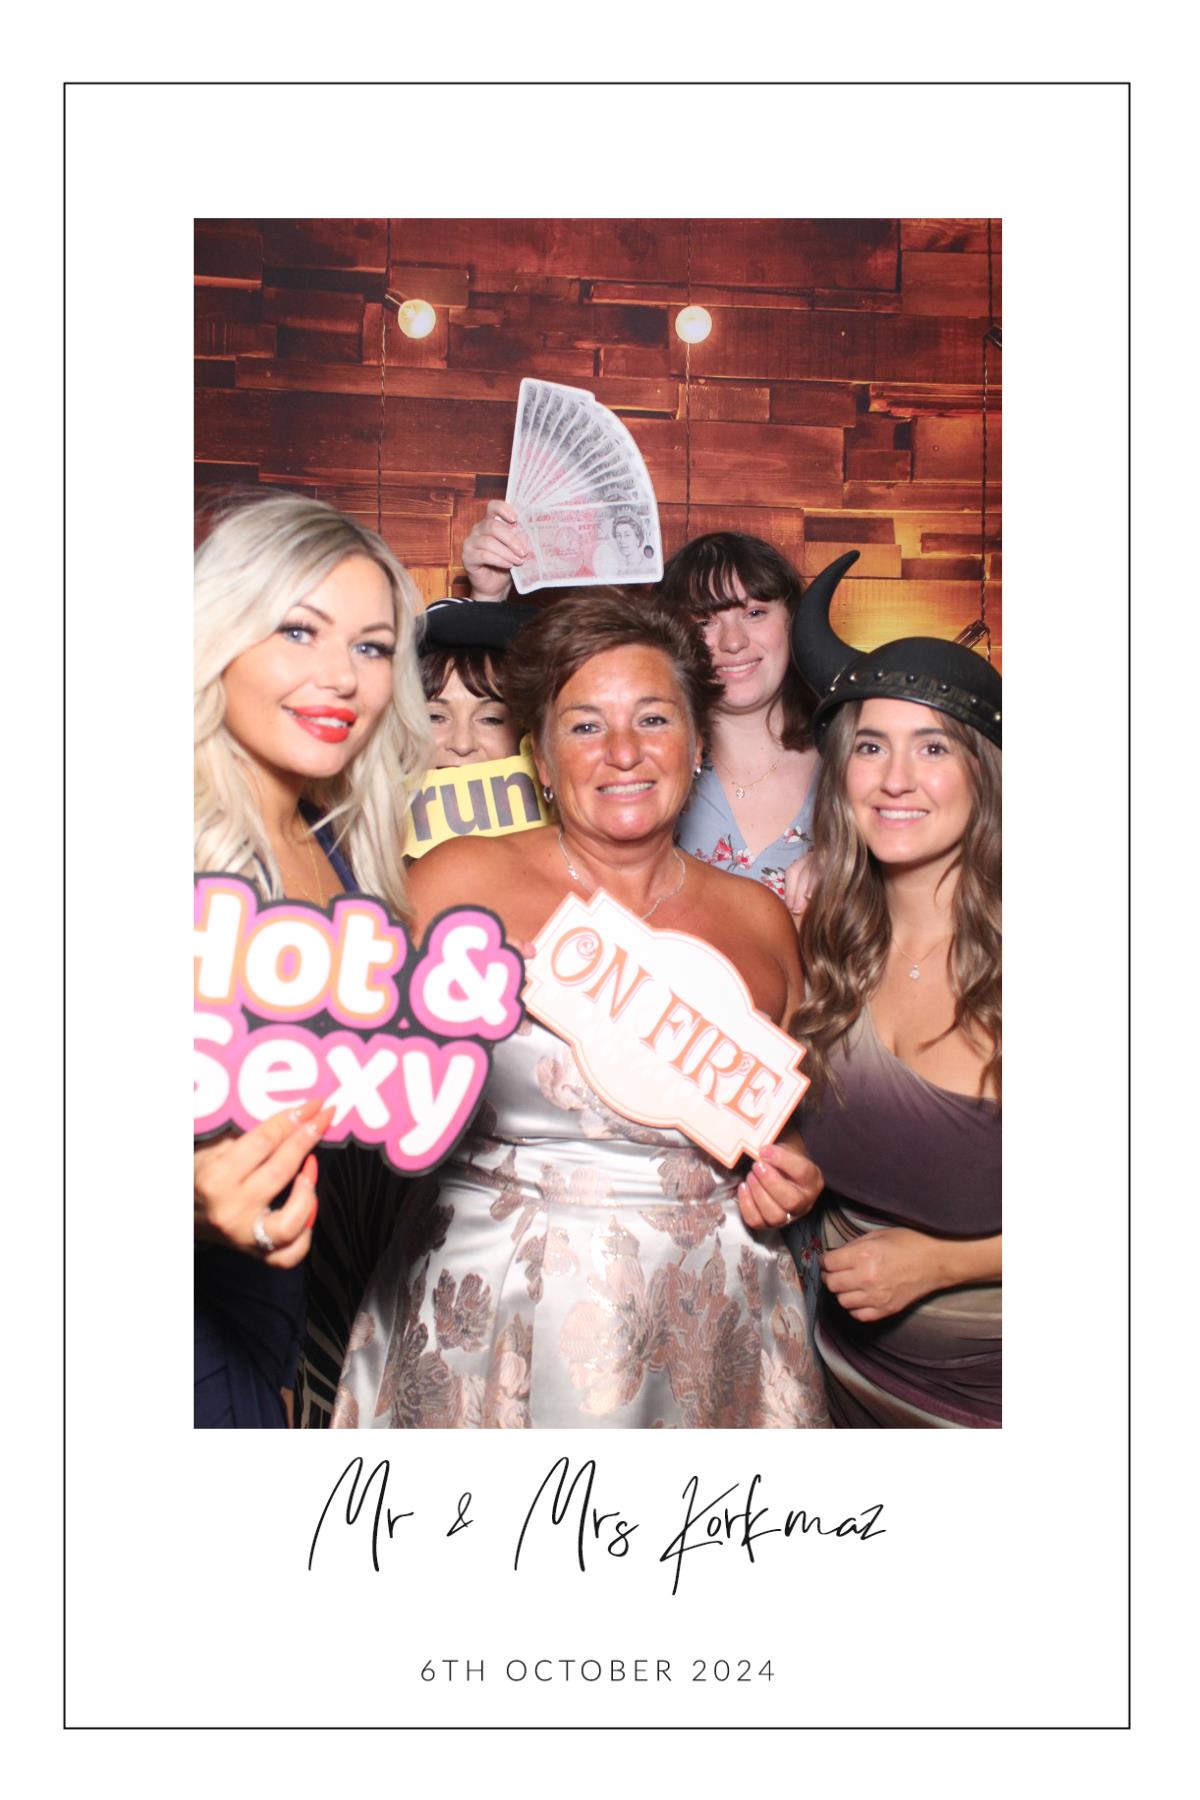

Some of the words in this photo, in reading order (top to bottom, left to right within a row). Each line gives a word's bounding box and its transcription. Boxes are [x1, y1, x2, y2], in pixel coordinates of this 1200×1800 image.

[422, 925, 509, 1026] &
[550, 926, 653, 1022] ON
[639, 986, 783, 1130] FIRE
